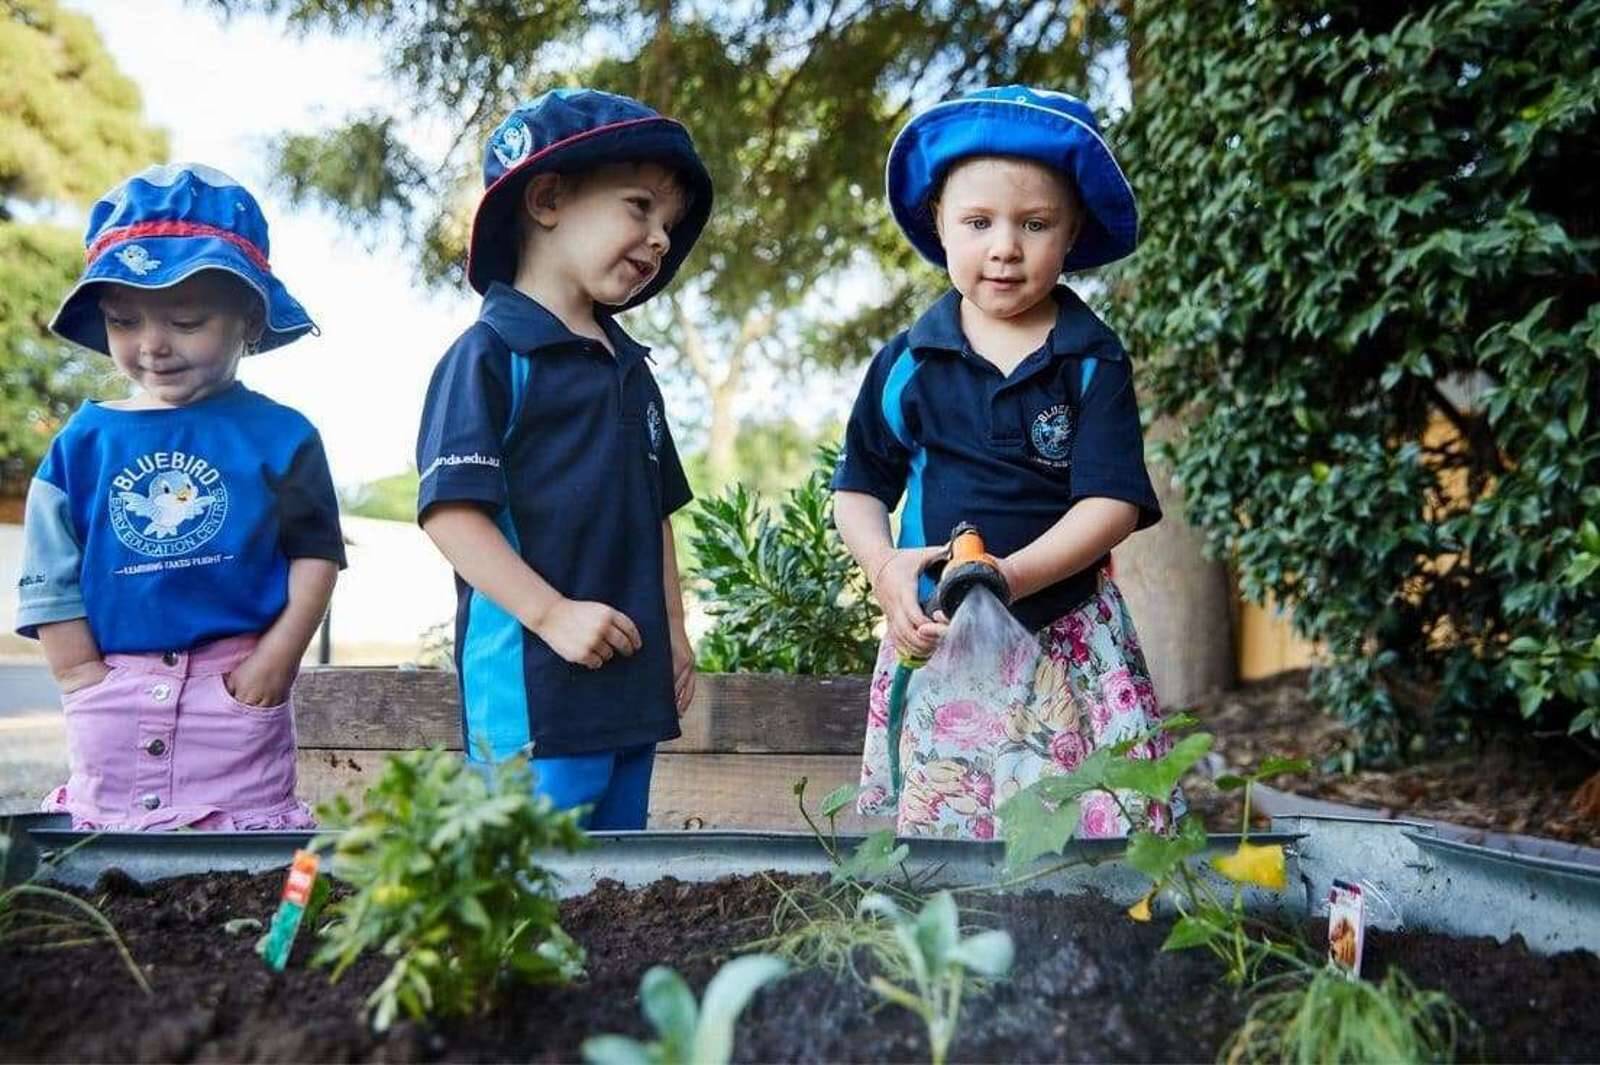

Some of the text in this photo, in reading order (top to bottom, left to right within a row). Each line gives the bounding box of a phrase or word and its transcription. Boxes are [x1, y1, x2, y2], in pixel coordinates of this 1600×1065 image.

[112, 451, 220, 491] BLUEBIRD
[123, 530, 196, 554] EDUCATION
[196, 487, 225, 540] CENTRES
[164, 558, 191, 569] TAKES
[192, 554, 222, 566] FLIGHT
